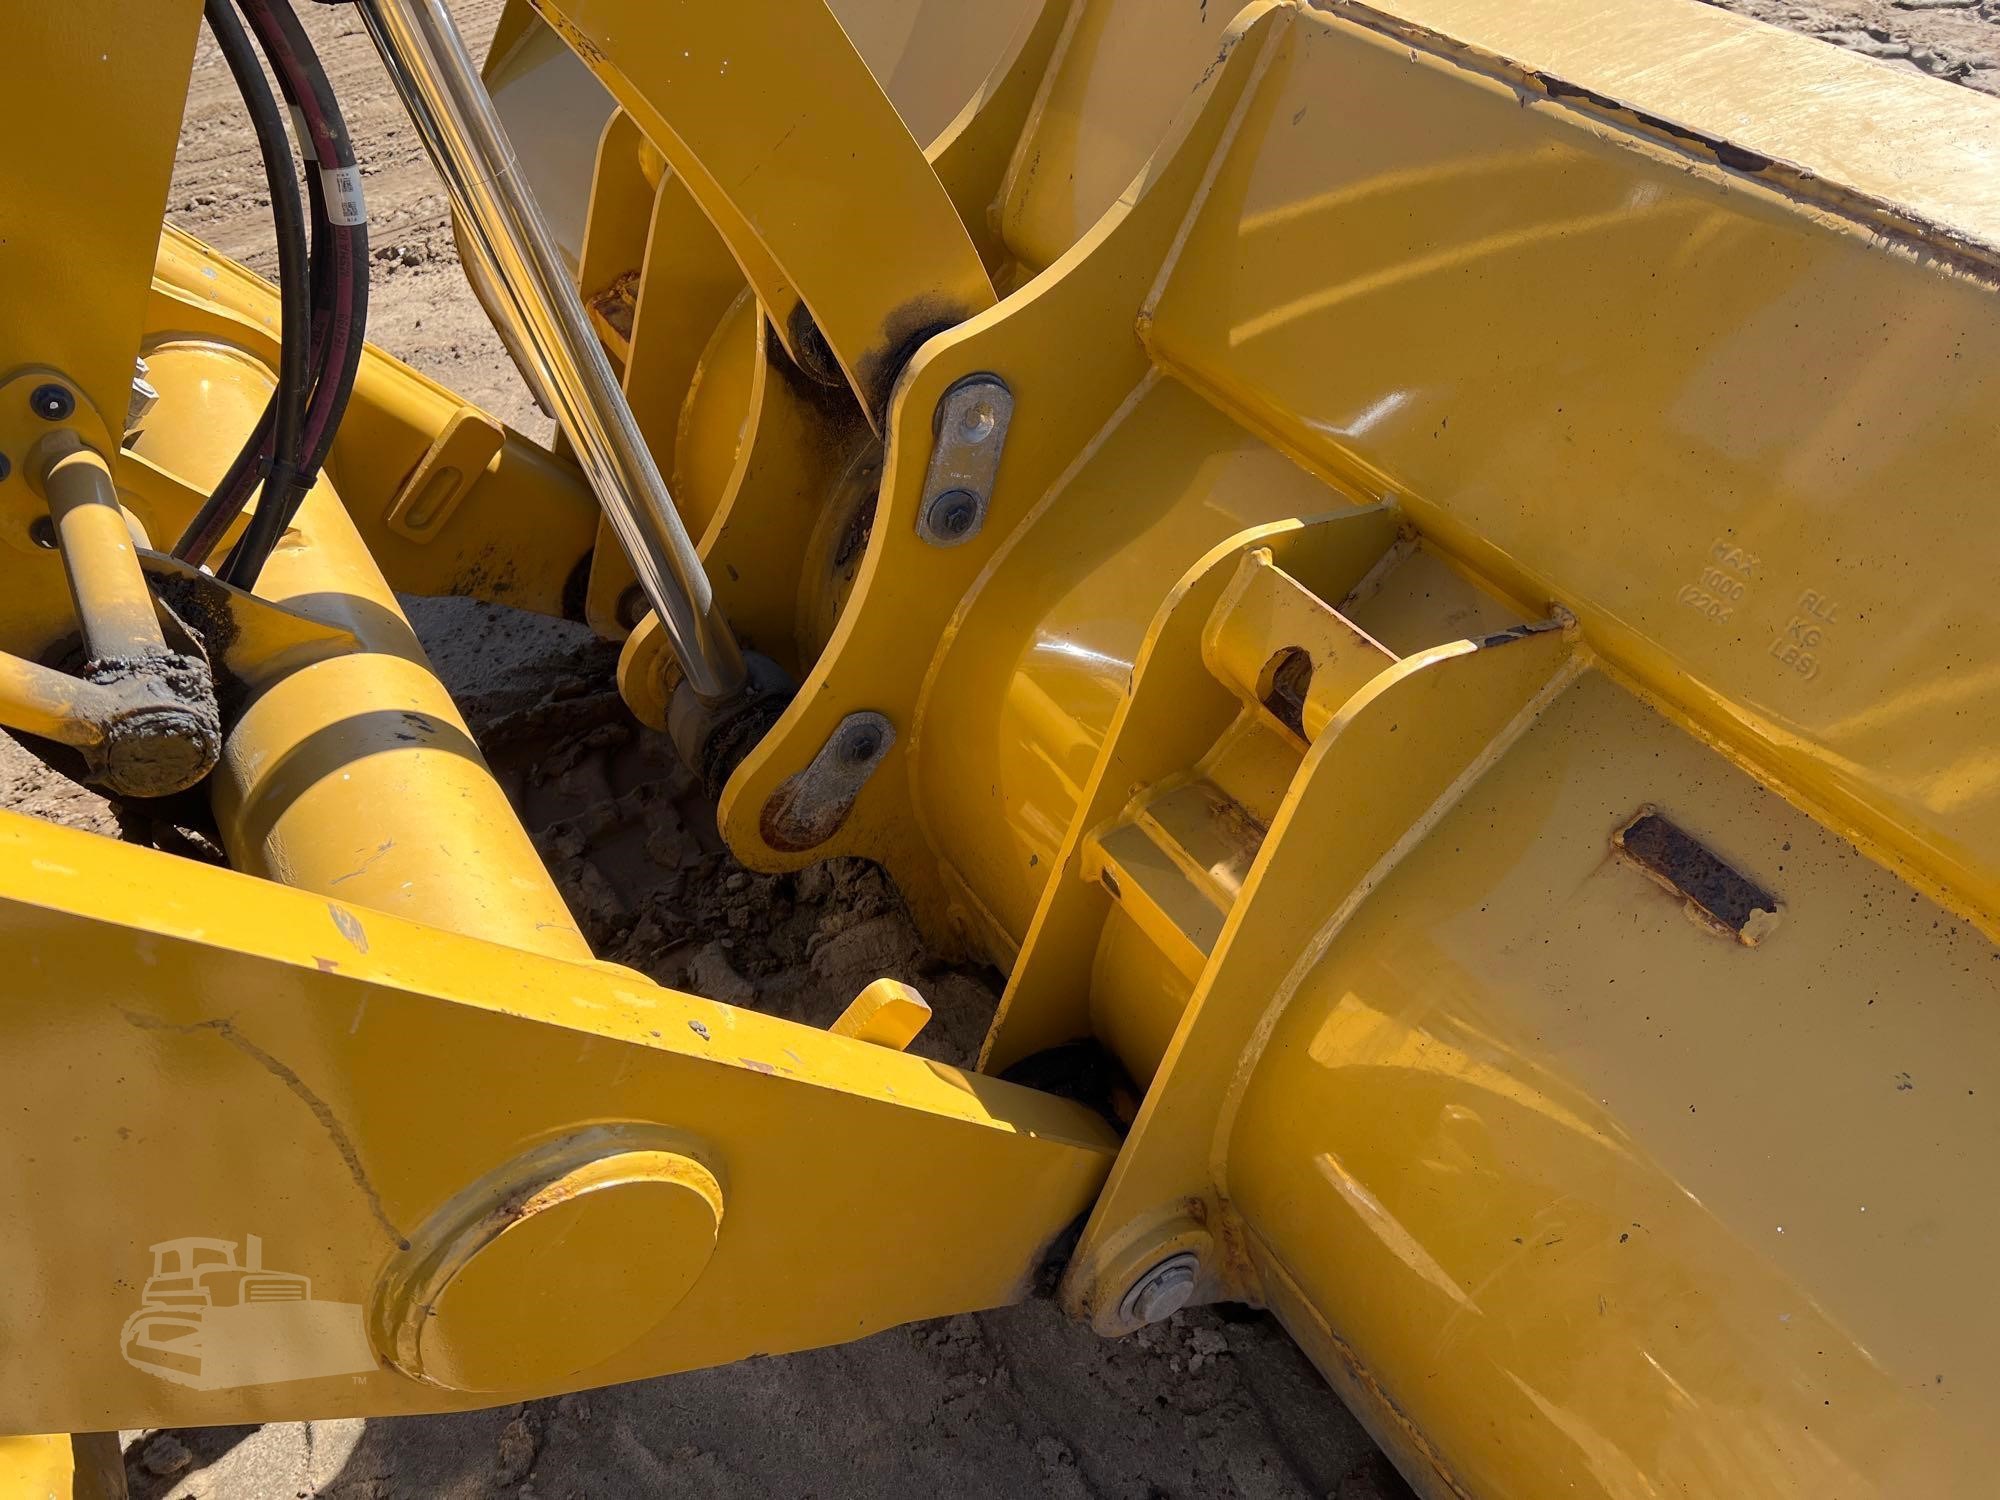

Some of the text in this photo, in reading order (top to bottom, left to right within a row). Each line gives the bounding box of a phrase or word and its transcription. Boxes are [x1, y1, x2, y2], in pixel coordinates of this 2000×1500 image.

[1712, 538, 1760, 576] MAX
[1702, 567, 1821, 648] 1000 KG
[1769, 638, 1820, 680] LBS)
